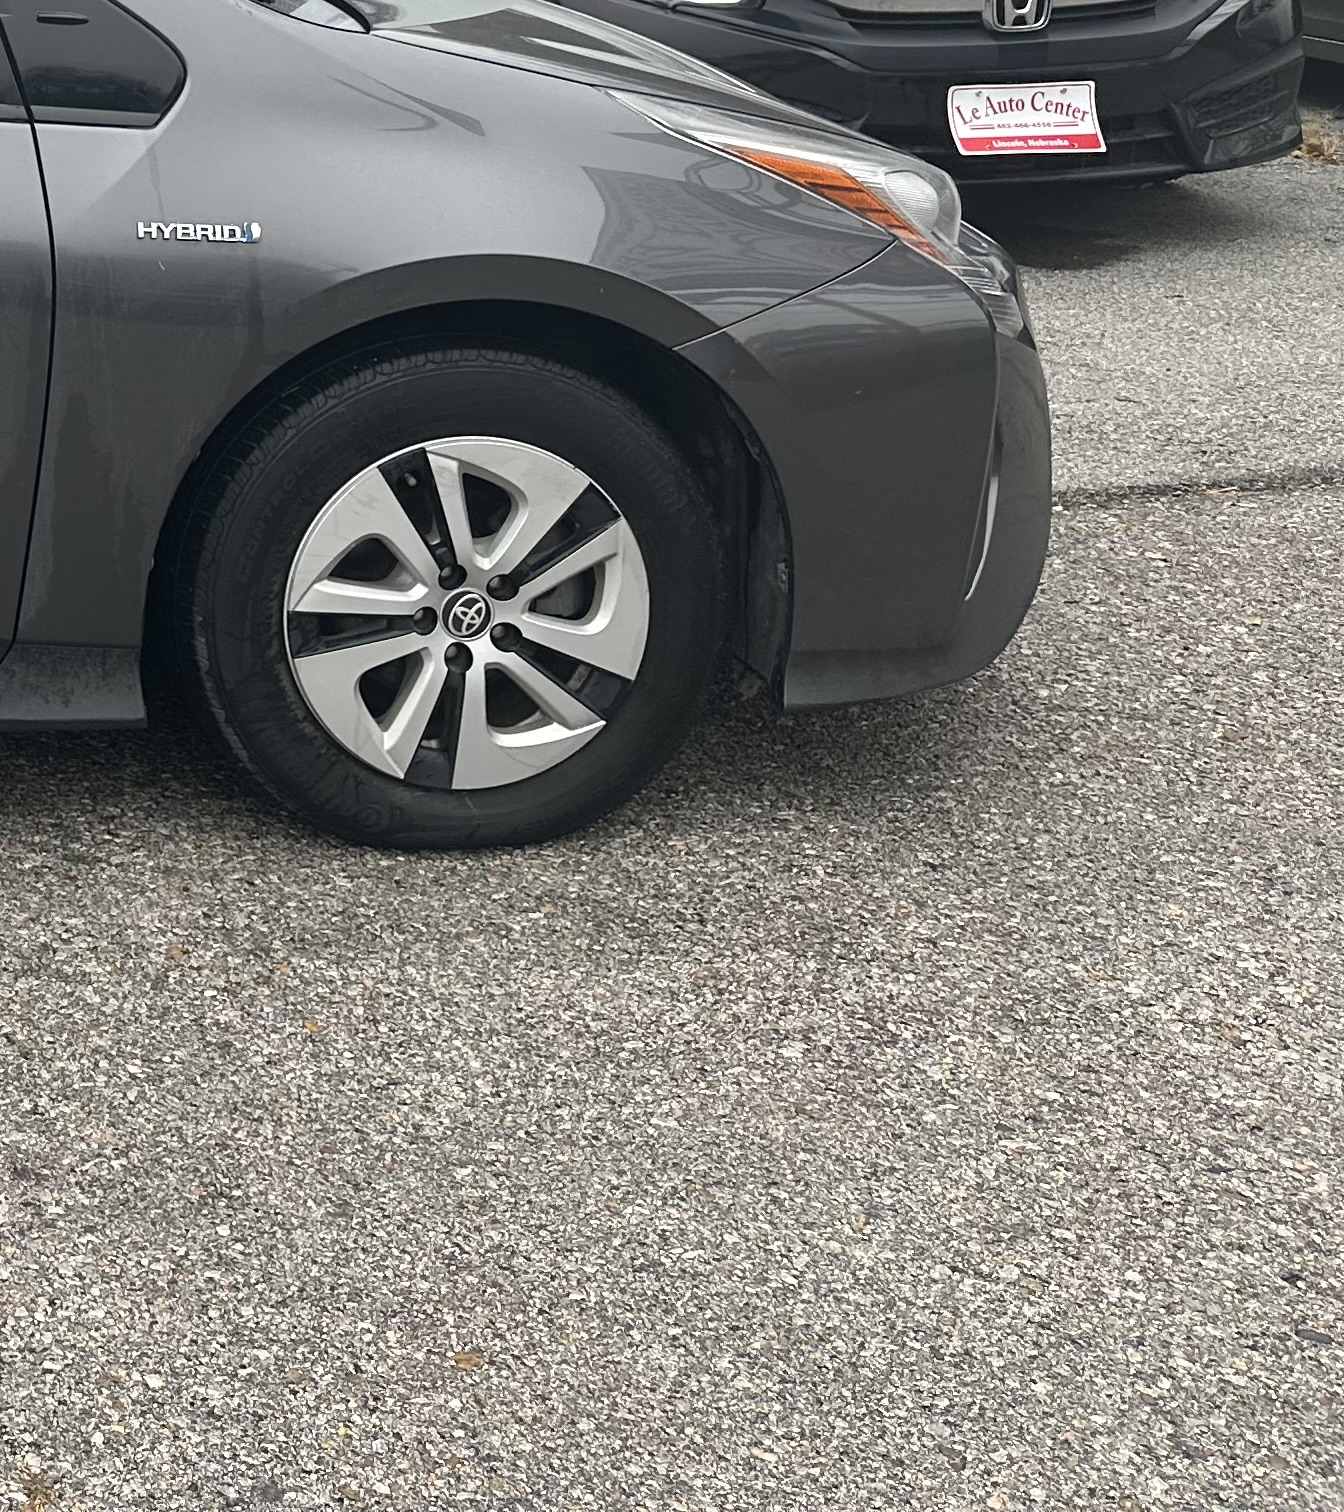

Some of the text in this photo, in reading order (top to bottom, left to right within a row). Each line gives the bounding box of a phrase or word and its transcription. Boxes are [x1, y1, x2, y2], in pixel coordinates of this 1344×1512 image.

[955, 91, 1090, 125] Le Auto Center
[136, 221, 242, 242] HYBRID
